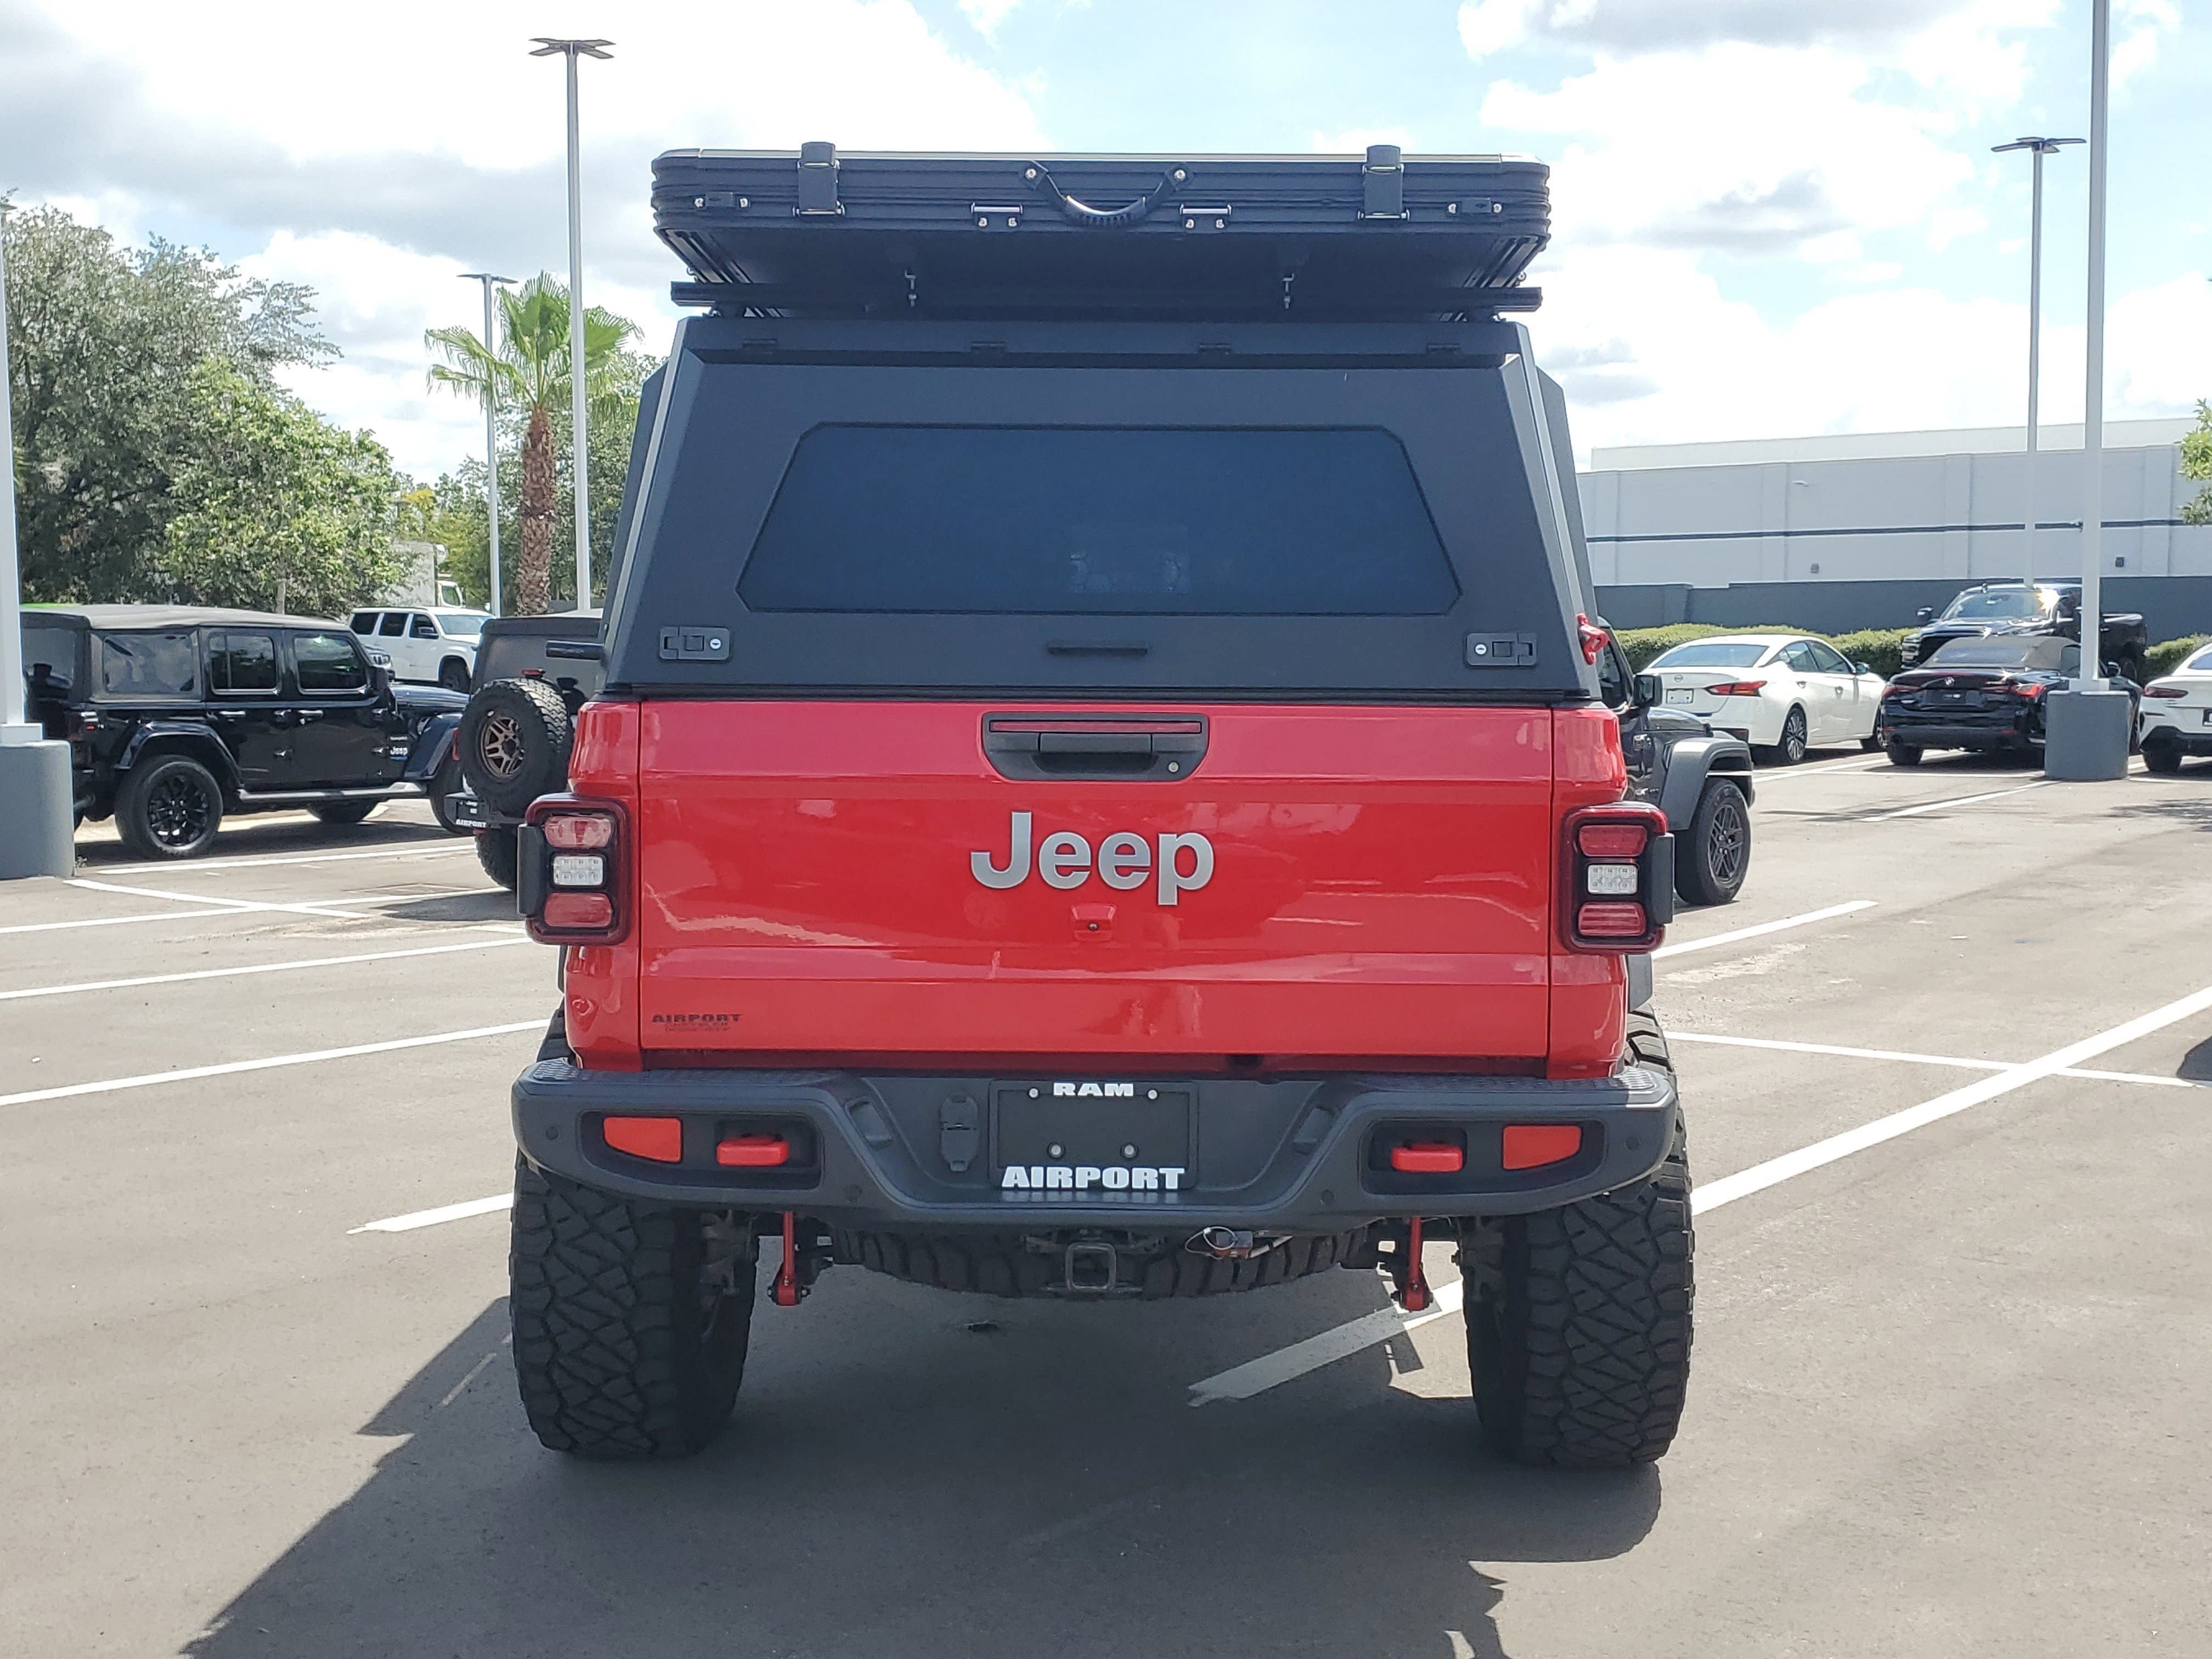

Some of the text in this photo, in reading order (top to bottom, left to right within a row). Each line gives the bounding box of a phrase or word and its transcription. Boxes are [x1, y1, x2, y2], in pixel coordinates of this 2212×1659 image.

[970, 810, 1215, 906] Jeep
[651, 1013, 743, 1023] AIRPORT
[1053, 1082, 1134, 1097] RAM
[1001, 1165, 1185, 1190] AIRPORT
